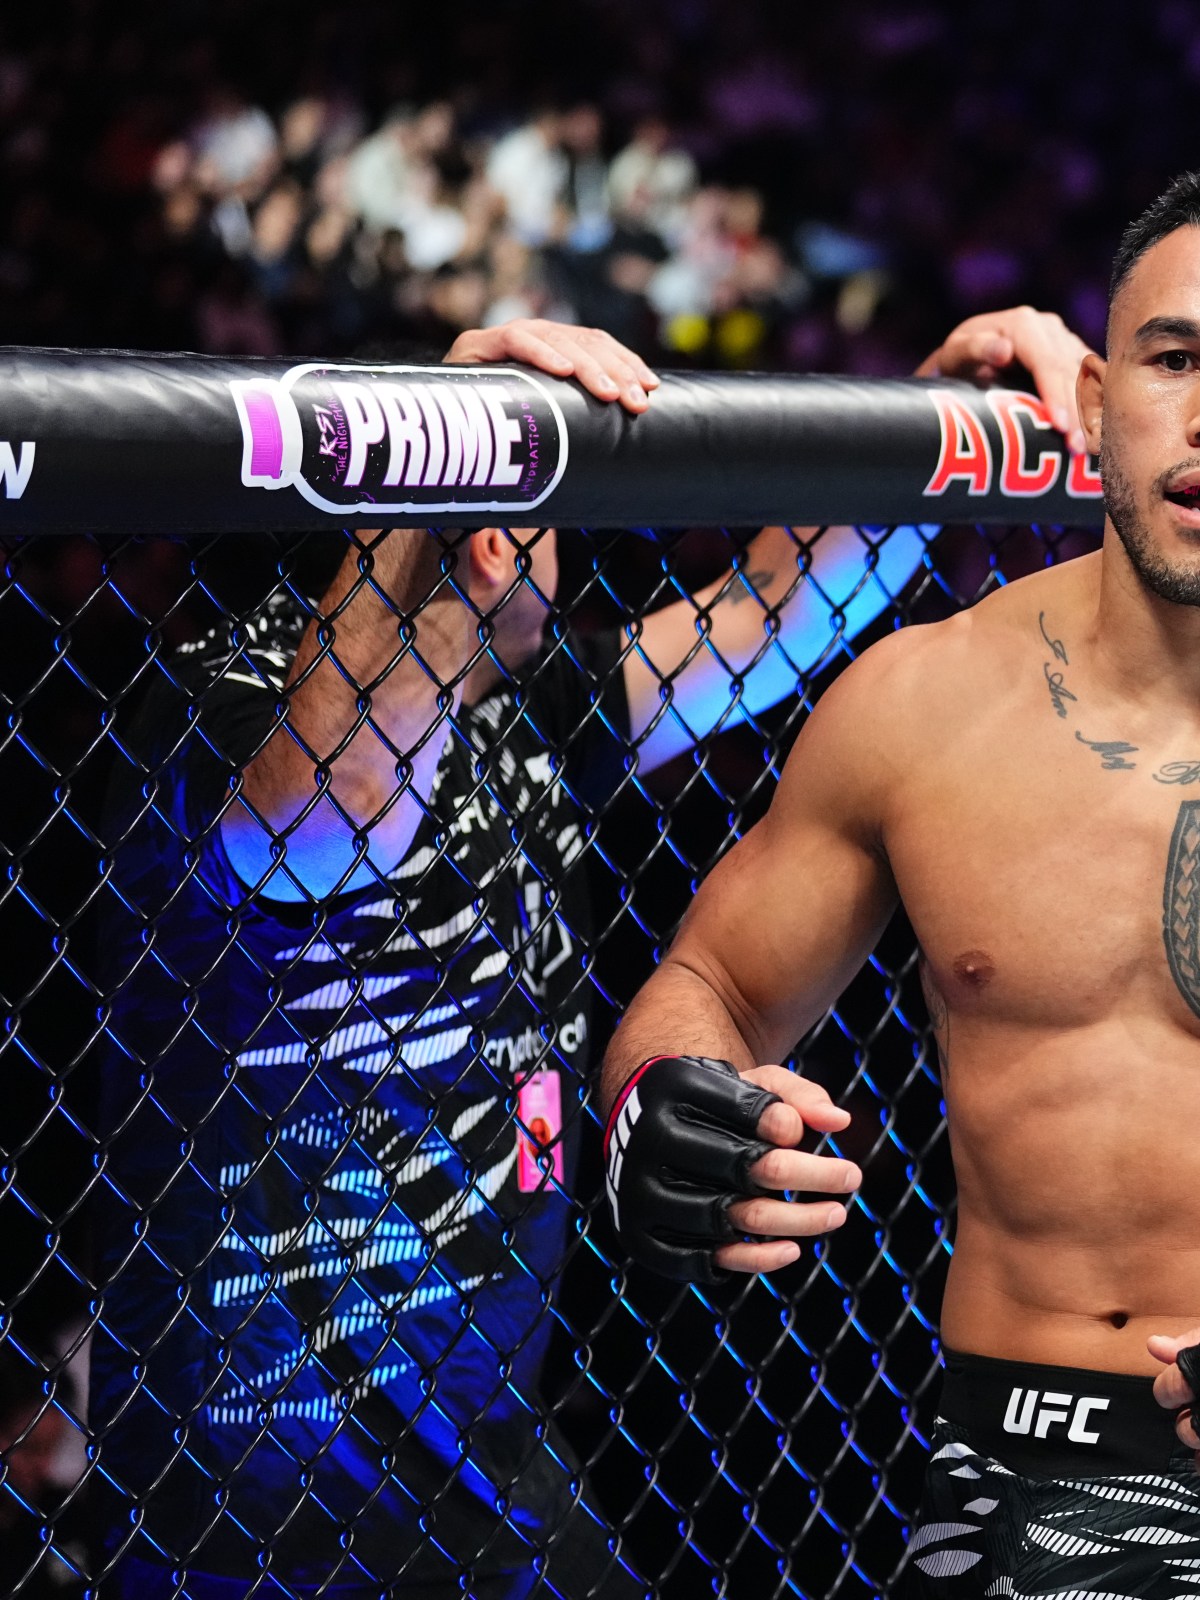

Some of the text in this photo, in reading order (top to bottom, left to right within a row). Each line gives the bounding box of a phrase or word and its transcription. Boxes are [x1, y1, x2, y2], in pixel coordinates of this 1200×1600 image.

[311, 403, 338, 458] KSI
[328, 382, 524, 487] PRIME
[1003, 1387, 1110, 1445] UFC
